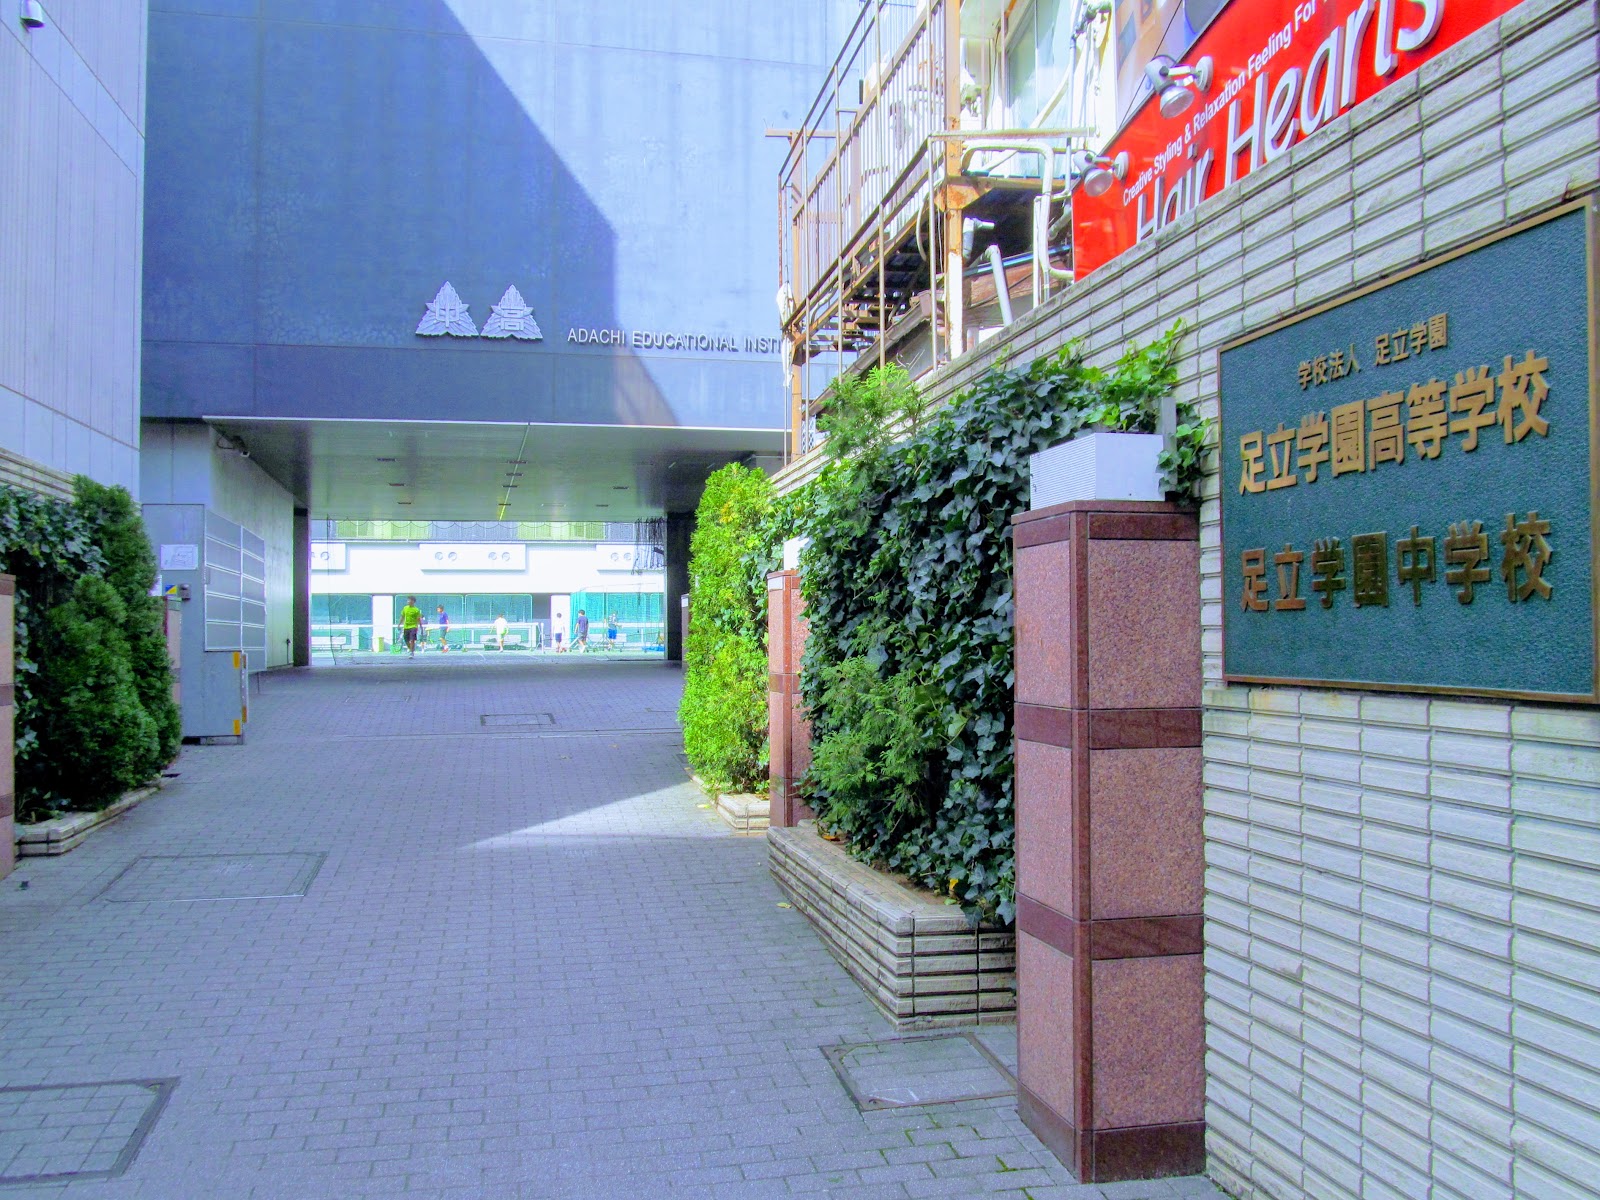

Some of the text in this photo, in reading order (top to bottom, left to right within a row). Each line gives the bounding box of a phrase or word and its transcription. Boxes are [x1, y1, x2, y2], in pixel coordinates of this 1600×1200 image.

[1123, 167, 1153, 207] Creative
[1154, 135, 1183, 175] Styling
[1184, 123, 1192, 144] &
[1193, 71, 1246, 135] Relaxation
[1248, 22, 1292, 80] Feeling
[1136, 143, 1214, 244] Hair
[567, 328, 626, 345] ADACHI
[632, 330, 738, 351] EDUCATIONAL
[1297, 313, 1448, 390] 学校法人 足立学園
[1239, 349, 1550, 495] 足立学園高等学校
[1239, 510, 1554, 612] 足立学園中学校
